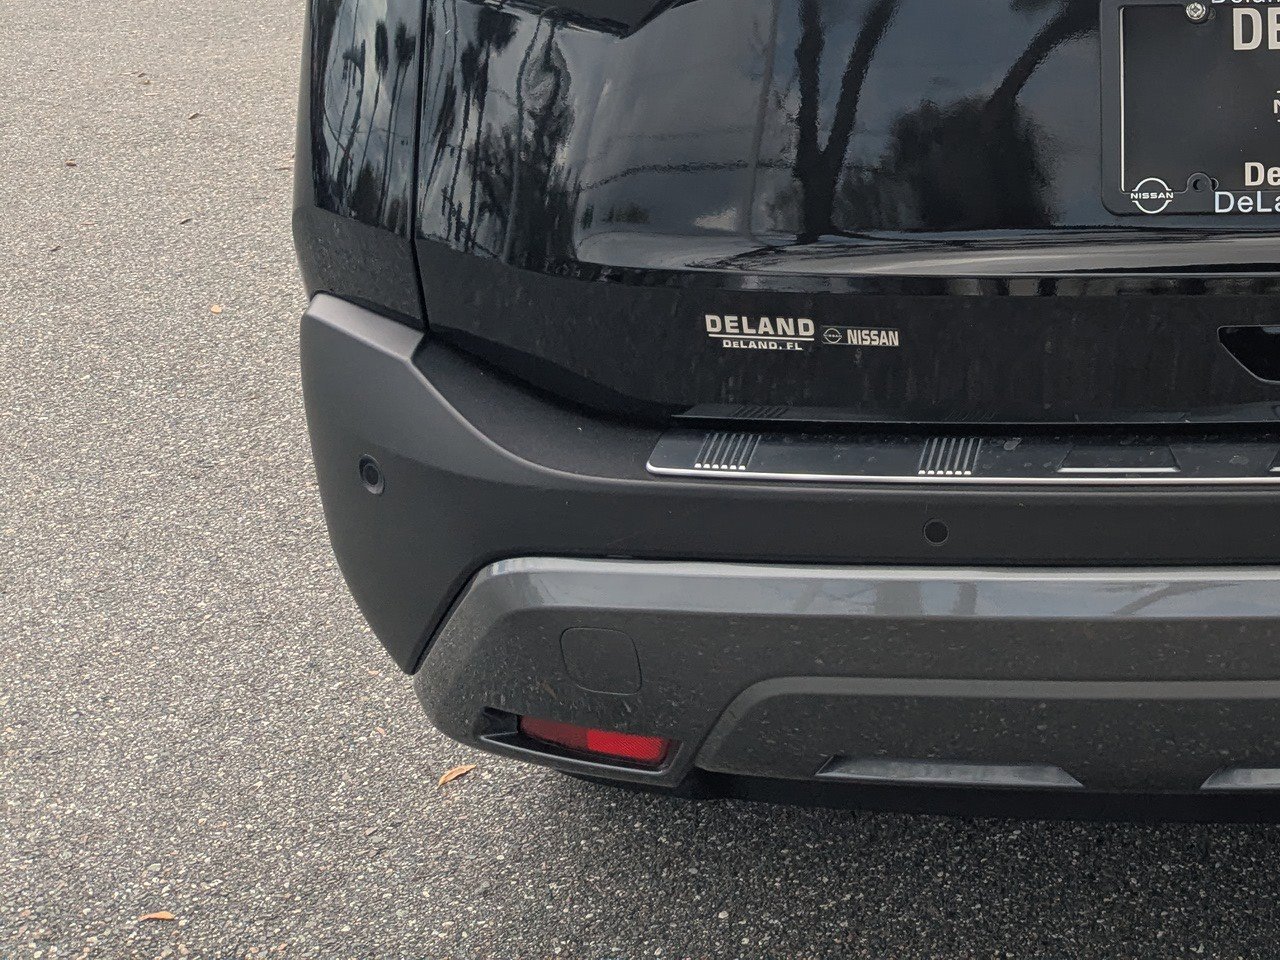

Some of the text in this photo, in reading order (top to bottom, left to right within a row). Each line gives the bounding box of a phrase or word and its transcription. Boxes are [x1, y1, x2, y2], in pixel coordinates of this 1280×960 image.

[1130, 192, 1174, 200] NISSAN
[704, 314, 815, 336] DELAND
[847, 328, 900, 346] NISSAN
[786, 341, 804, 351] FL
